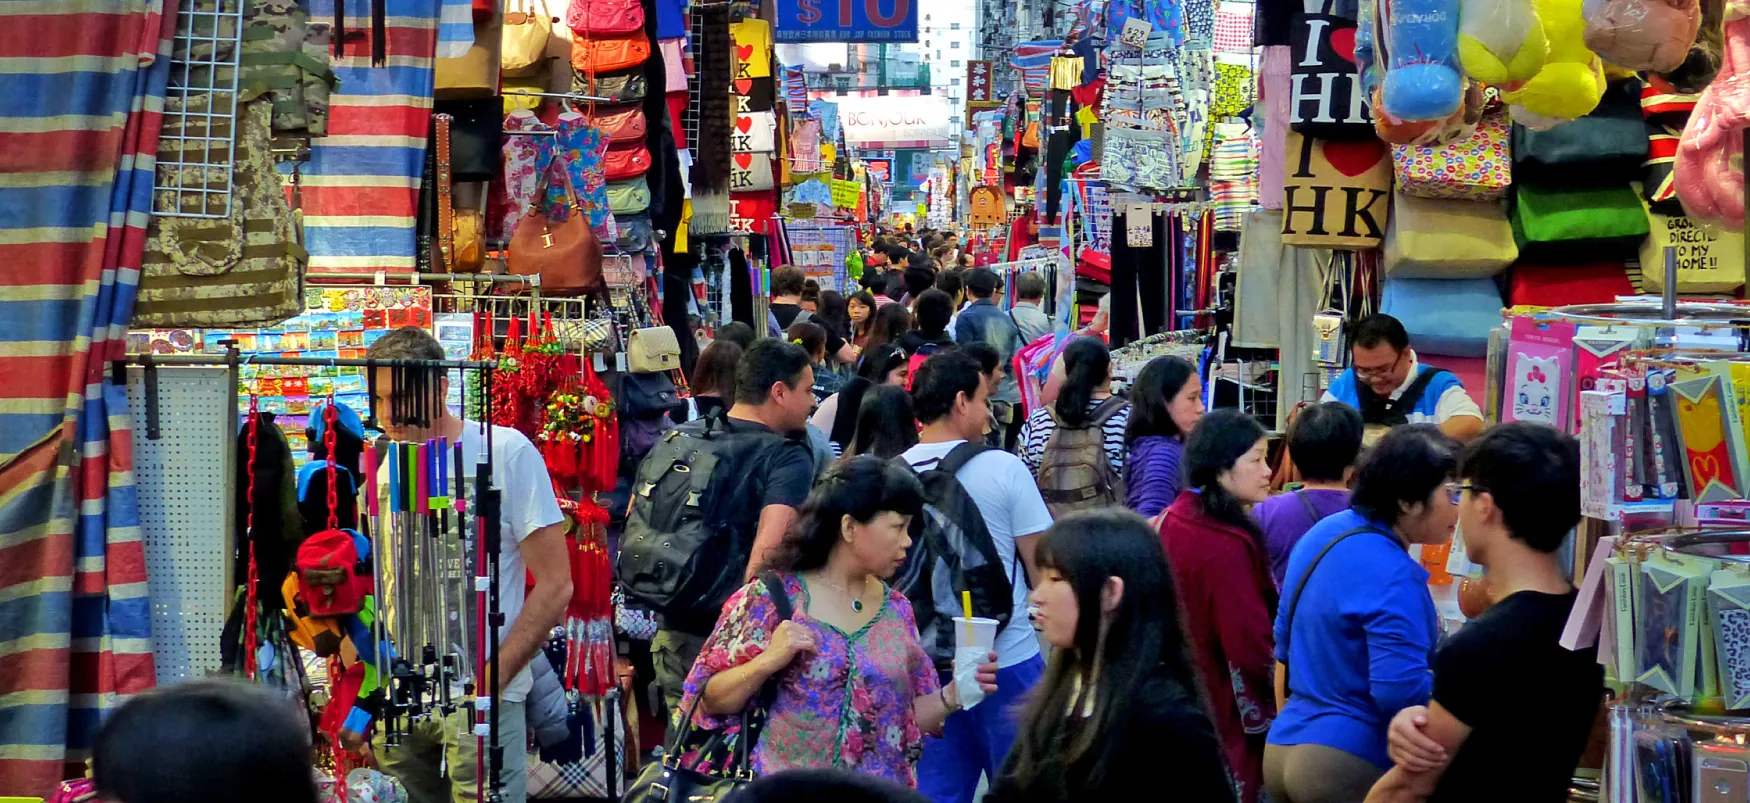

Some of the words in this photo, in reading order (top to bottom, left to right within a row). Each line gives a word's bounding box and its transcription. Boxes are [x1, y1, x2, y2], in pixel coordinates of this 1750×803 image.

[867, 30, 890, 39] FASHION
[738, 63, 751, 77] K
[737, 96, 751, 112] K
[848, 110, 926, 129] BONJOUR
[1282, 185, 1387, 238] HK
[1691, 245, 1709, 257] MY
[284, 380, 303, 388] 香港
